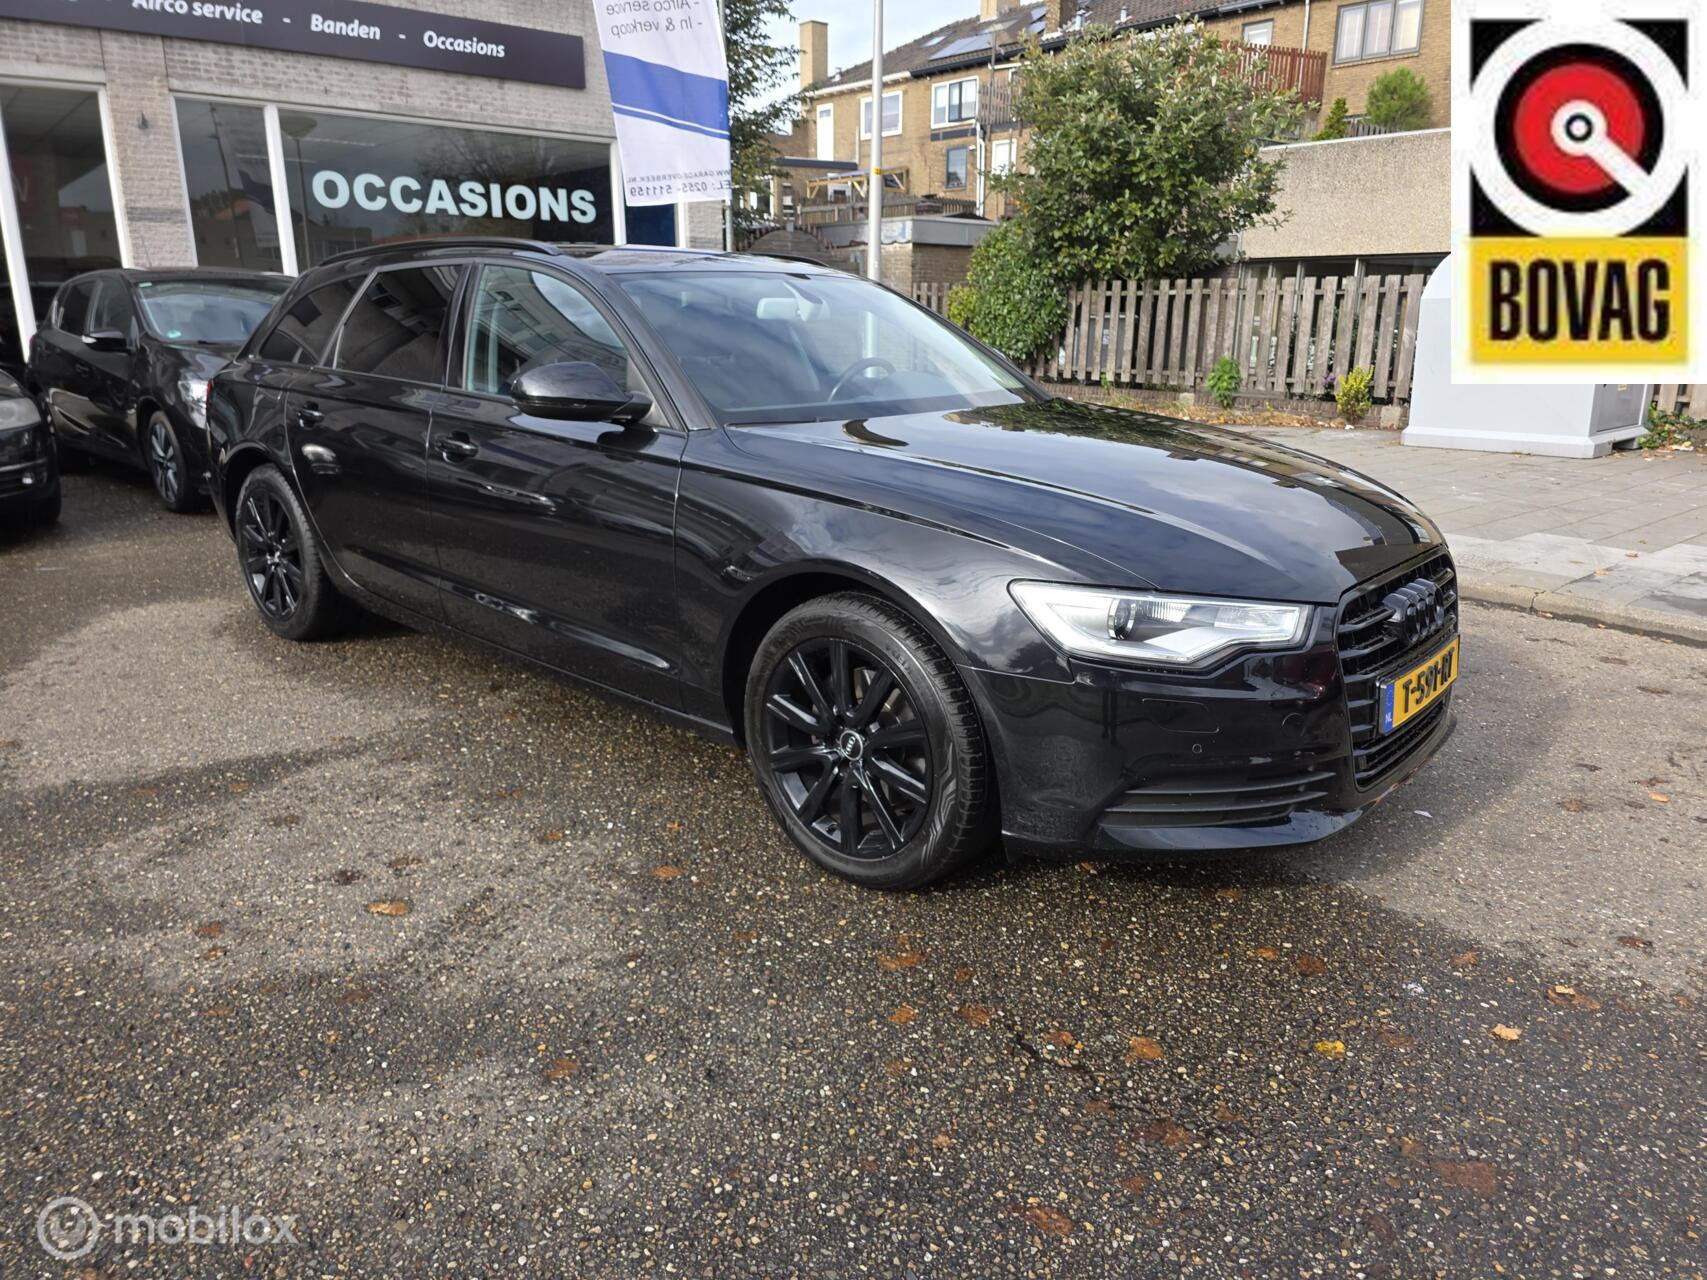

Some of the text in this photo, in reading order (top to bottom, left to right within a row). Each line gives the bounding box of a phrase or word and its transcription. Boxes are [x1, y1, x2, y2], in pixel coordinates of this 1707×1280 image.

[192, 2, 263, 24] service
[310, 13, 381, 40] Banden
[423, 30, 505, 58] Occasions
[312, 170, 597, 224] OCCASIONS
